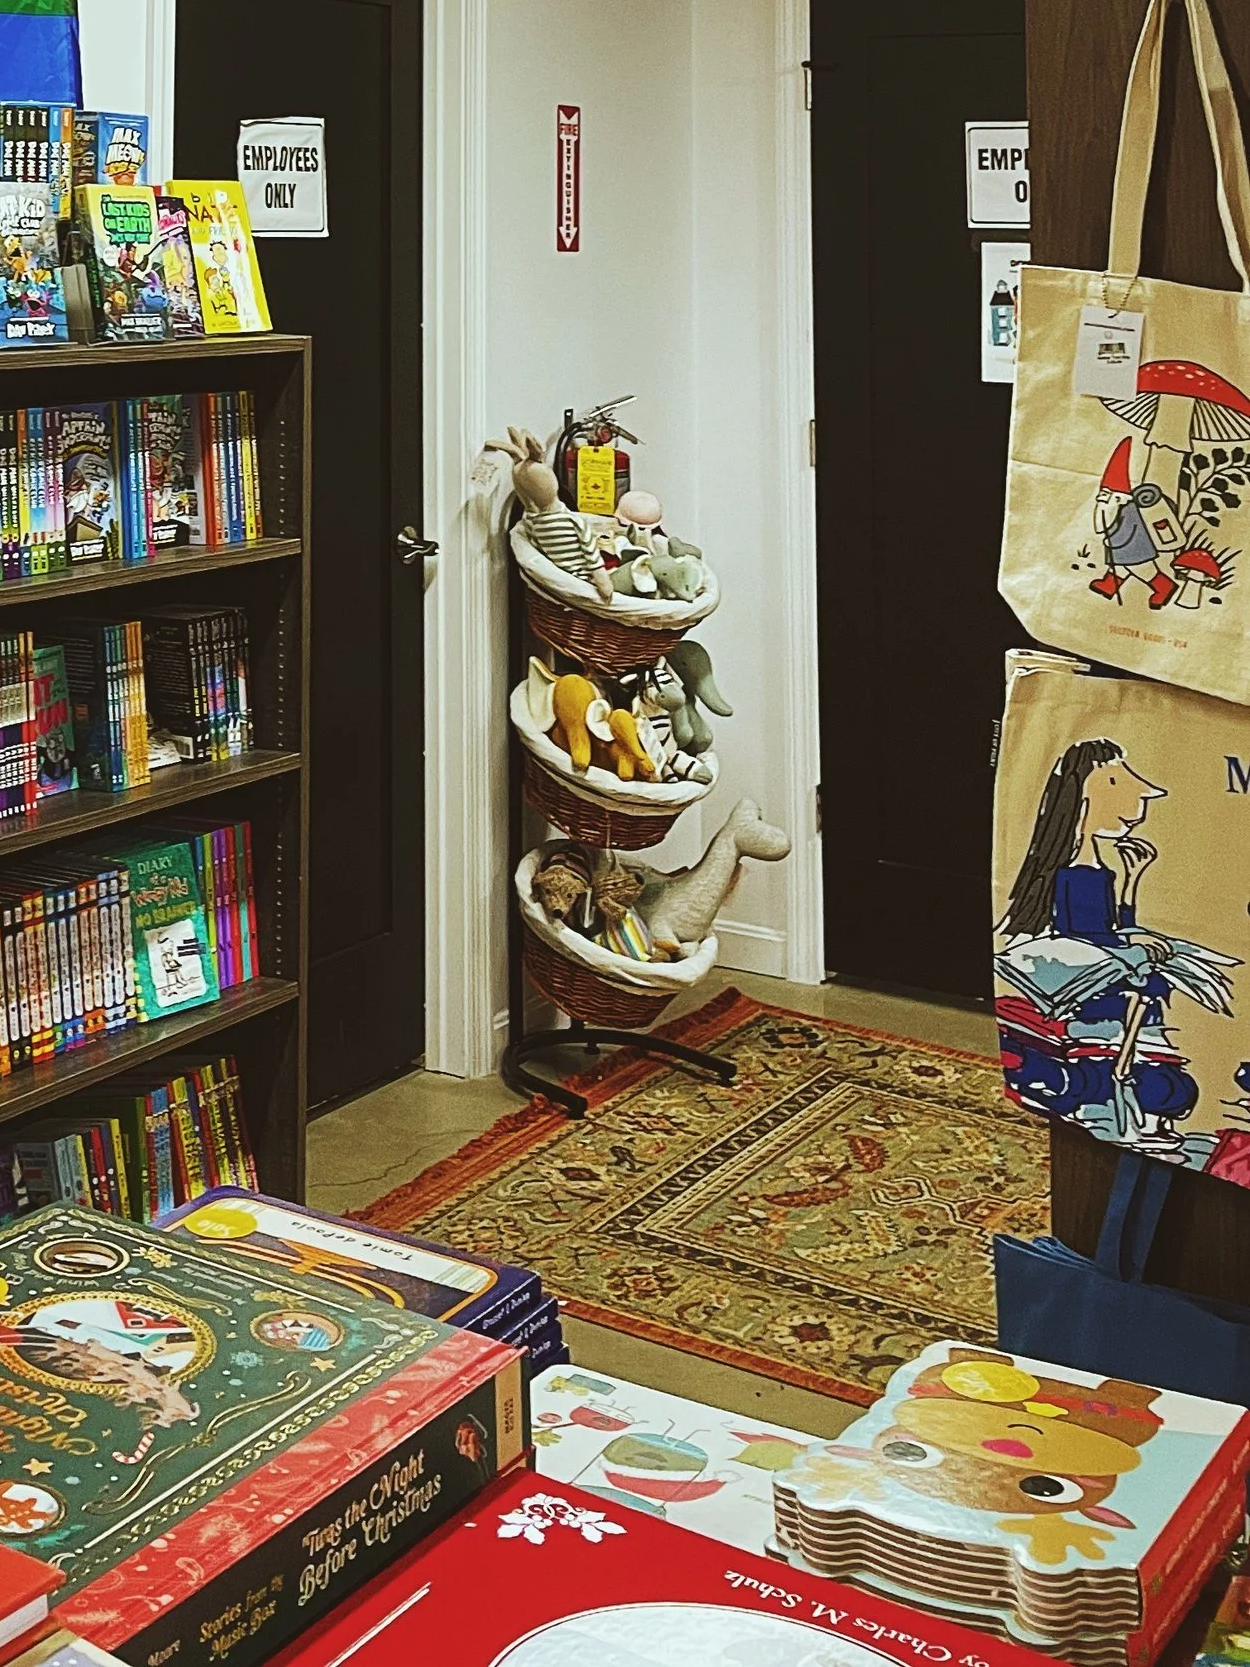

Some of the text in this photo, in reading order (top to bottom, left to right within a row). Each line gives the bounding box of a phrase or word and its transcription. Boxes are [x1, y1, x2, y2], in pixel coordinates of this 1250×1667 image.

[243, 145, 318, 172] EMPLOYEES
[265, 183, 296, 208] ONLY
[117, 217, 152, 231] EARTH
[137, 856, 173, 875] DIARY
[197, 1220, 231, 1238] Sale
[363, 1241, 413, 1262] Tomie
[344, 1497, 367, 1529] the
[369, 1449, 425, 1510] Night
[298, 1474, 441, 1607] Before Christmas
[200, 1603, 241, 1642] Stories
[723, 1569, 952, 1662] Charles M. Schulz
[210, 1600, 277, 1662] Music Box
[147, 1639, 180, 1667] Moore
